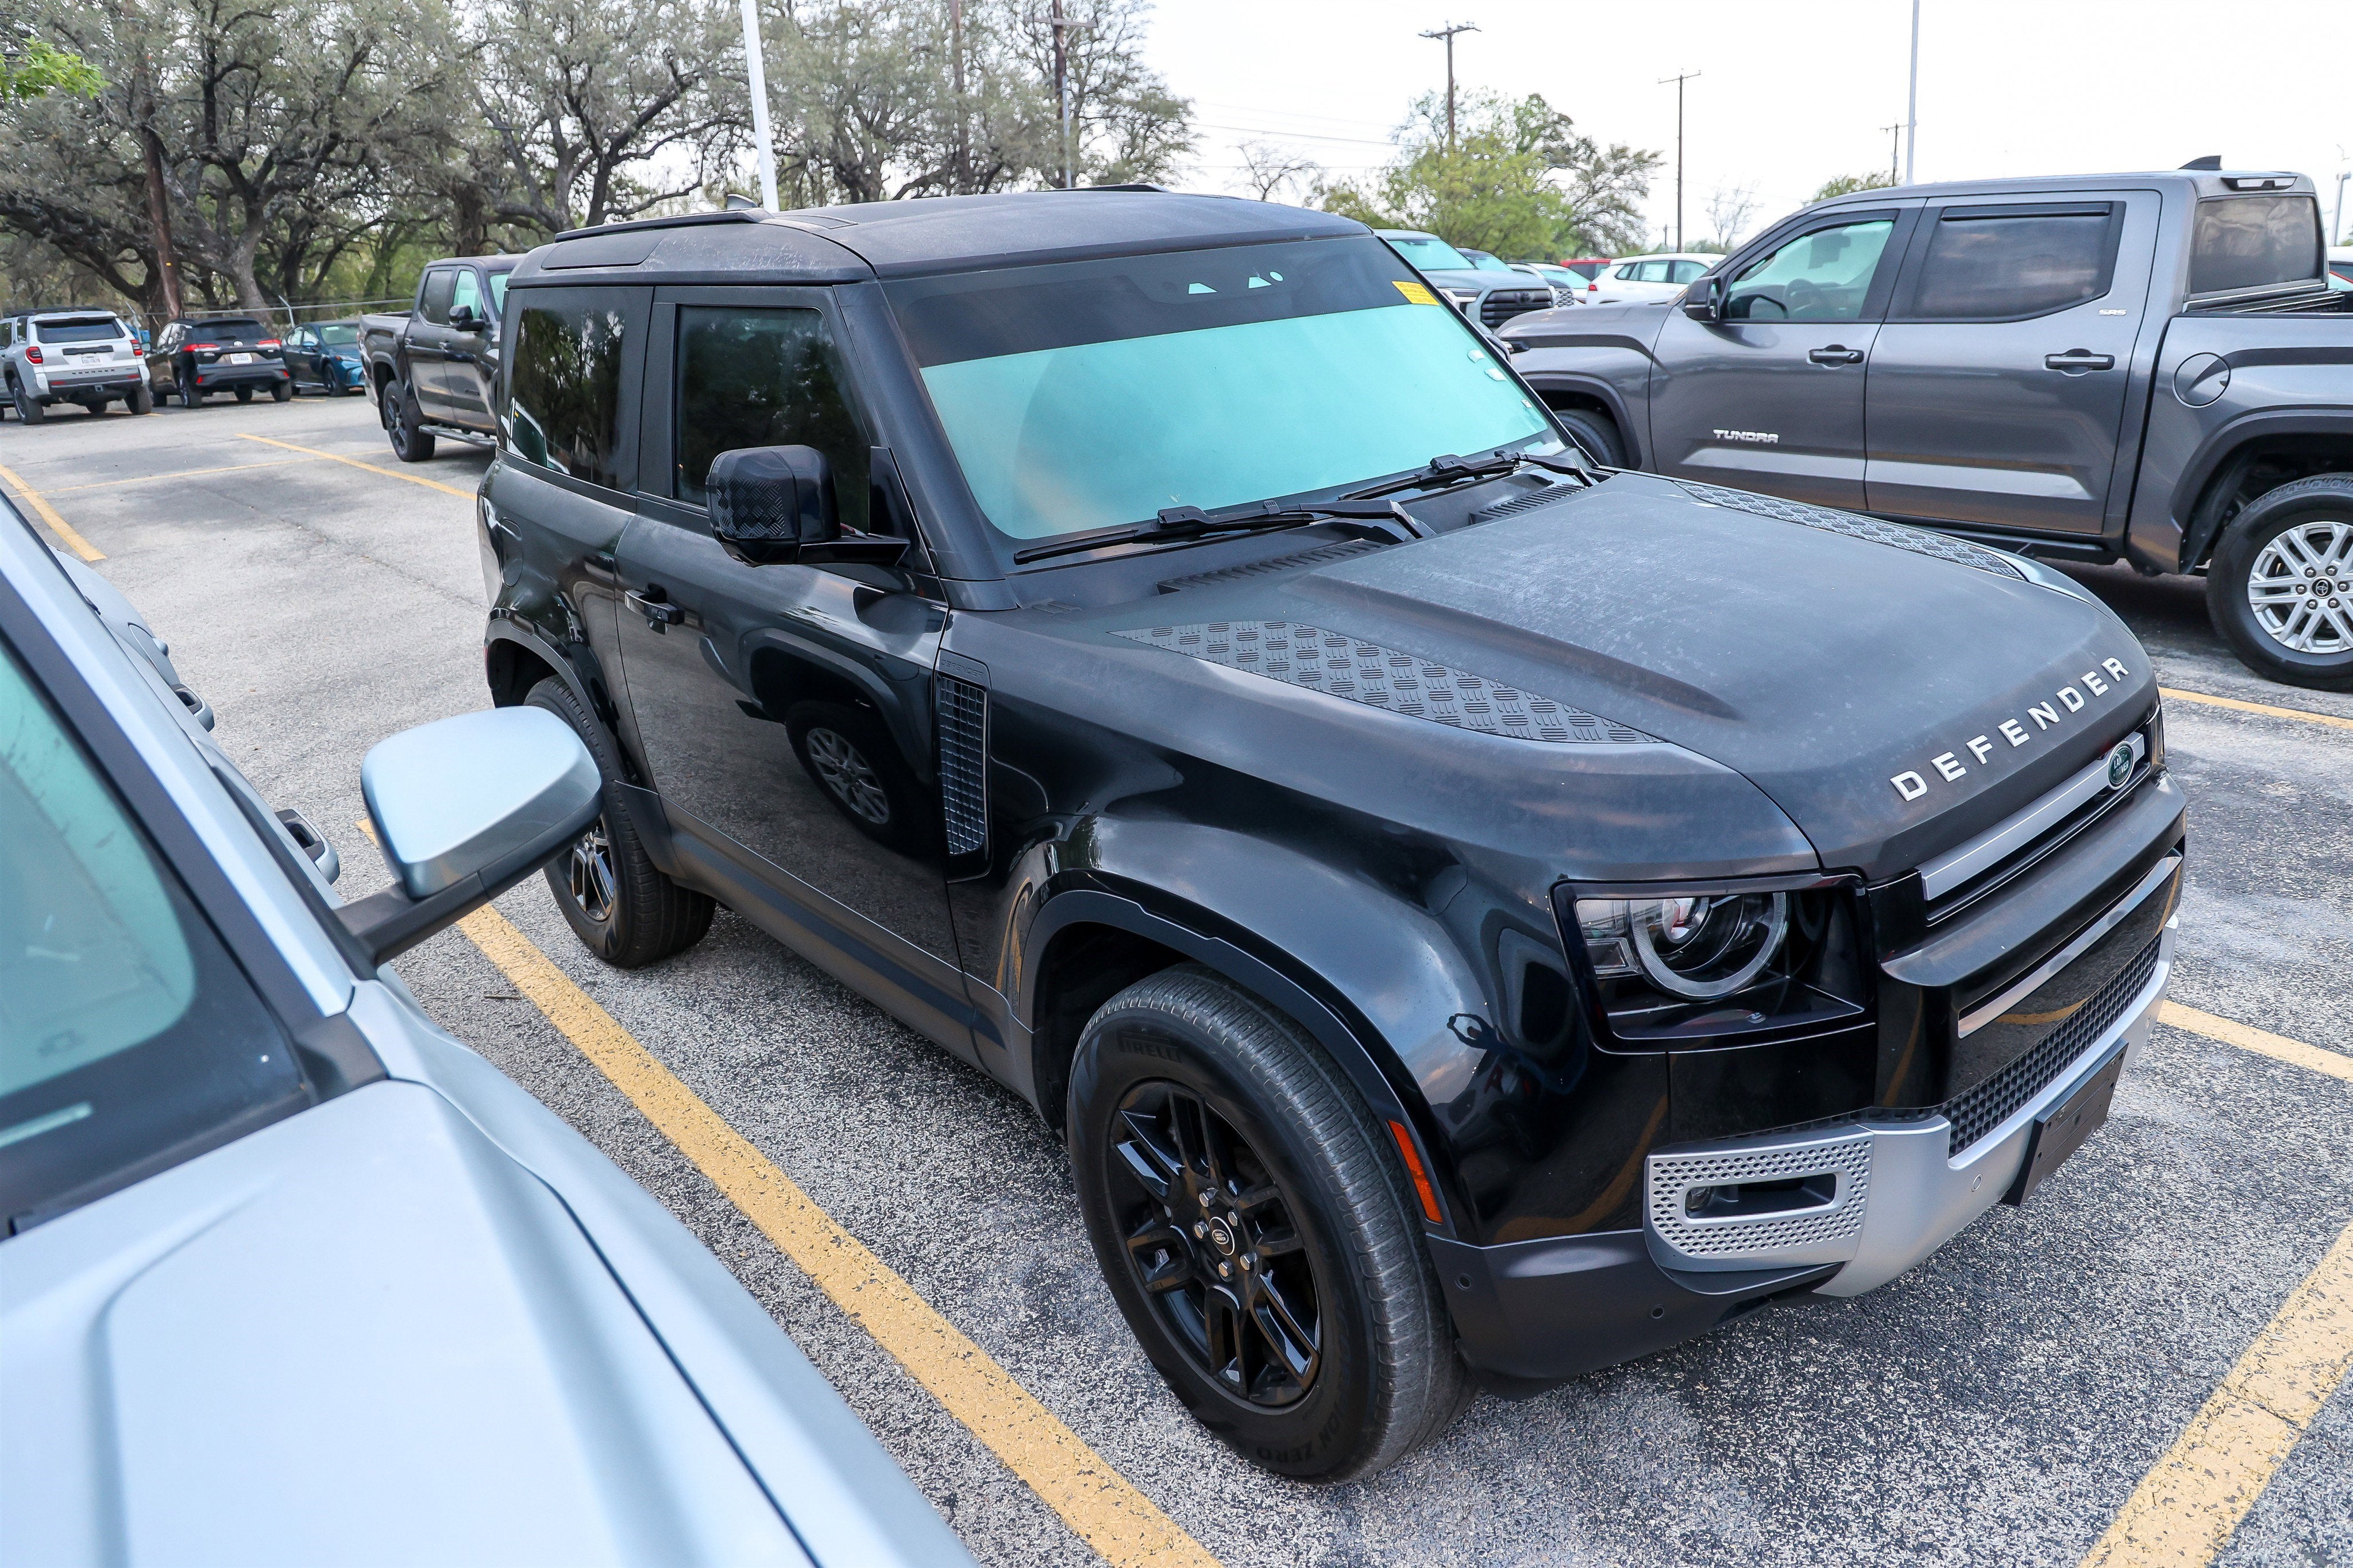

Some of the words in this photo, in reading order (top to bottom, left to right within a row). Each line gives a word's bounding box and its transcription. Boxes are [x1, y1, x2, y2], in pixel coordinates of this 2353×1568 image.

[1712, 428, 1779, 444] TUNDRA
[942, 659, 983, 678] DEFENDER
[1889, 656, 2130, 802] DEFENDER
[1116, 1031, 1182, 1063] PIRELLI
[1256, 1440, 1316, 1463] ZERO
